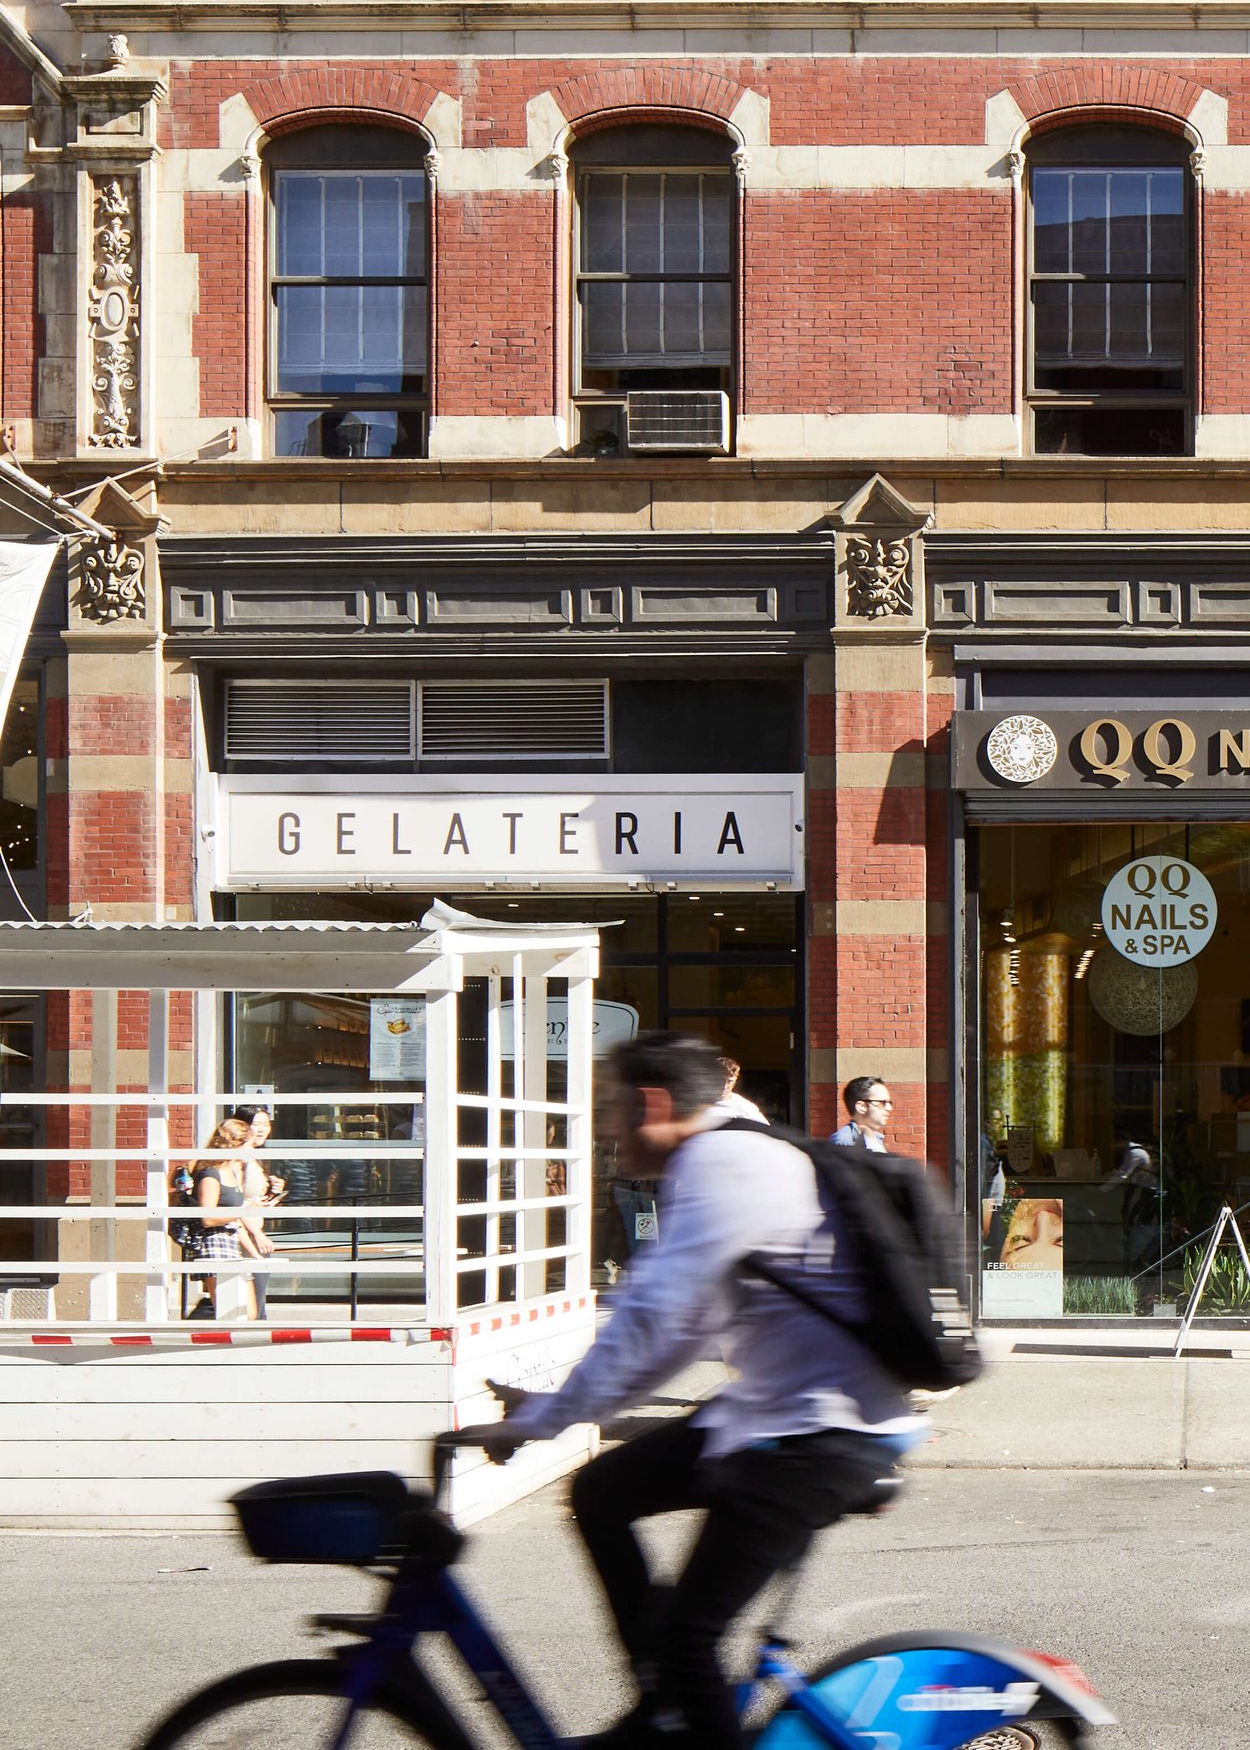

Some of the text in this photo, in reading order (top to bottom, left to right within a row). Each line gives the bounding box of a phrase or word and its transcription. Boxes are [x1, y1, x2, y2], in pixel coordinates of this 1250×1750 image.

[1079, 718, 1197, 782] QQ
[278, 811, 745, 855] GELATERIA
[1127, 863, 1191, 900] QQ
[1111, 903, 1209, 931] NAILS
[1124, 934, 1191, 955] & SPA
[987, 1262, 1044, 1270] FEEL GREAT
[996, 1272, 1024, 1280] LOOK
[1025, 1272, 1058, 1280] GREAT
